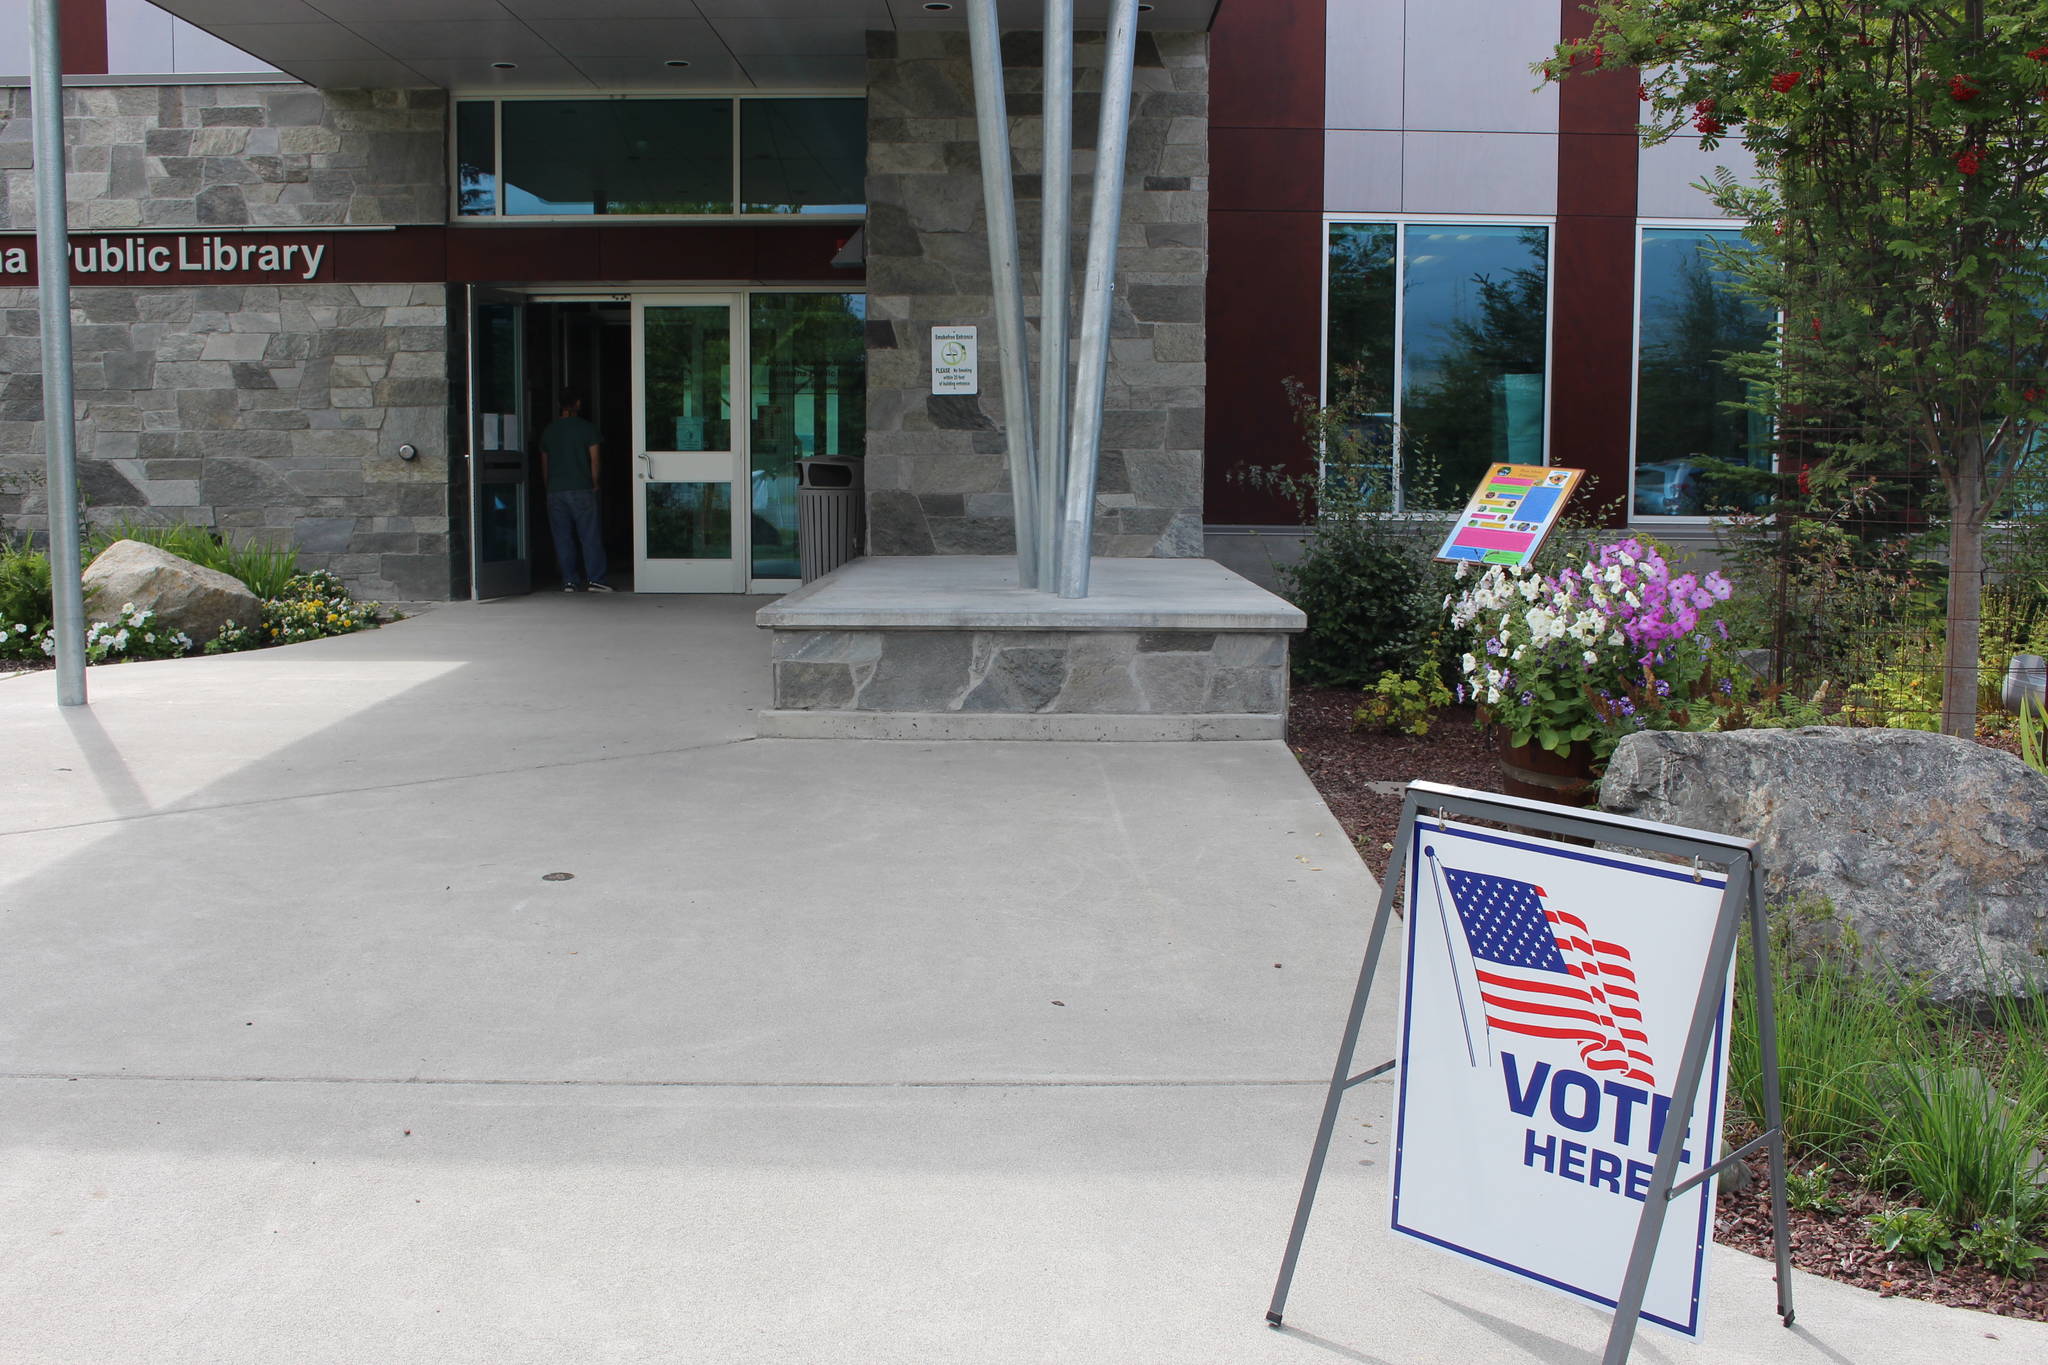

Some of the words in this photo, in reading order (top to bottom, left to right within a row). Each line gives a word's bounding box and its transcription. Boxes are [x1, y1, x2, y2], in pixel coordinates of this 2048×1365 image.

[0, 247, 28, 273] a
[67, 237, 171, 273] ublic
[178, 236, 325, 280] Library
[1523, 1128, 1654, 1203] HERE
